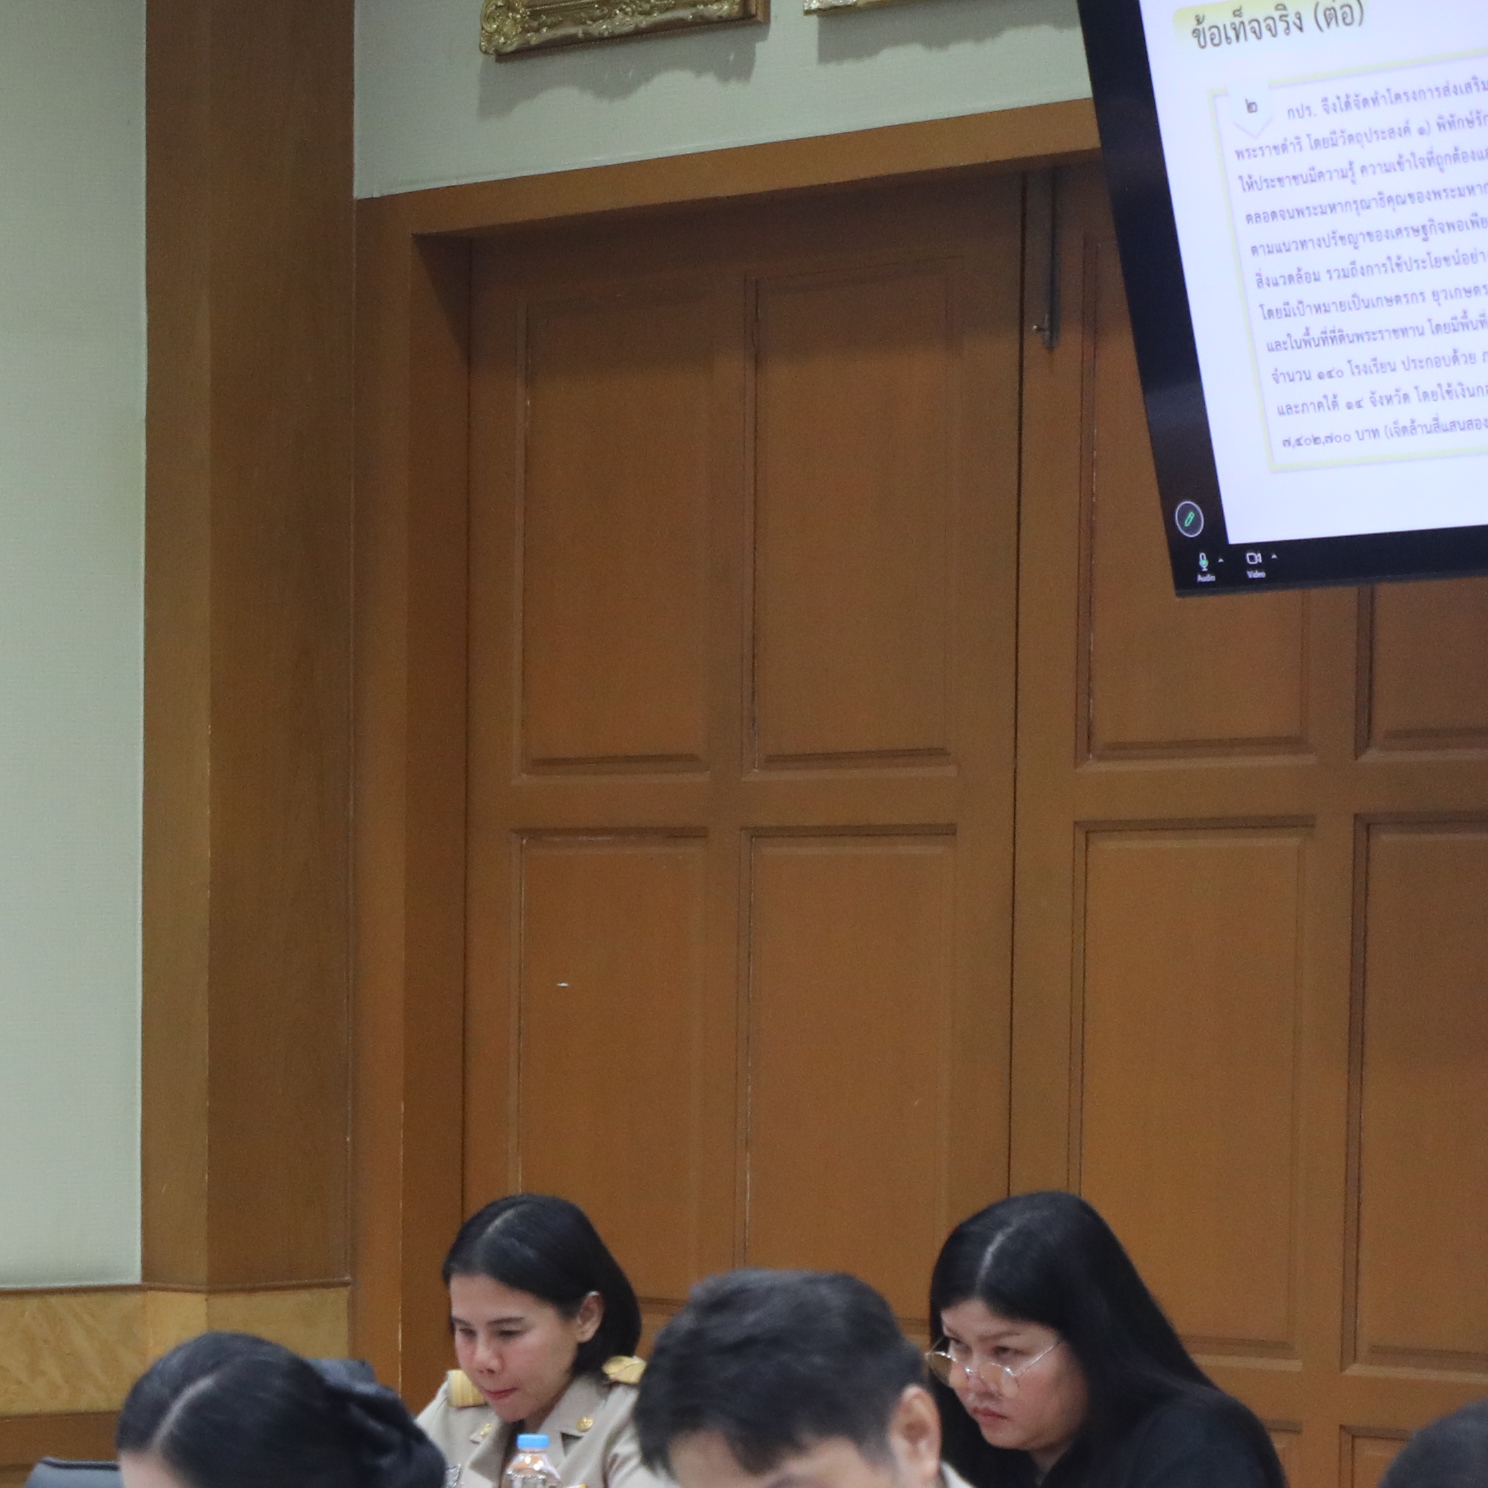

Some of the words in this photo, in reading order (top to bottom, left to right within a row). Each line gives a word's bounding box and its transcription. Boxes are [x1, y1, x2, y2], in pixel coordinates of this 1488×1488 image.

[1191, 3, 1305, 50] ข้อเท็จจริง
[1244, 98, 1259, 114] ๒
[1287, 103, 1317, 120] กปร.
[1271, 367, 1311, 385] จำนวน
[1355, 425, 1381, 442] บาท
